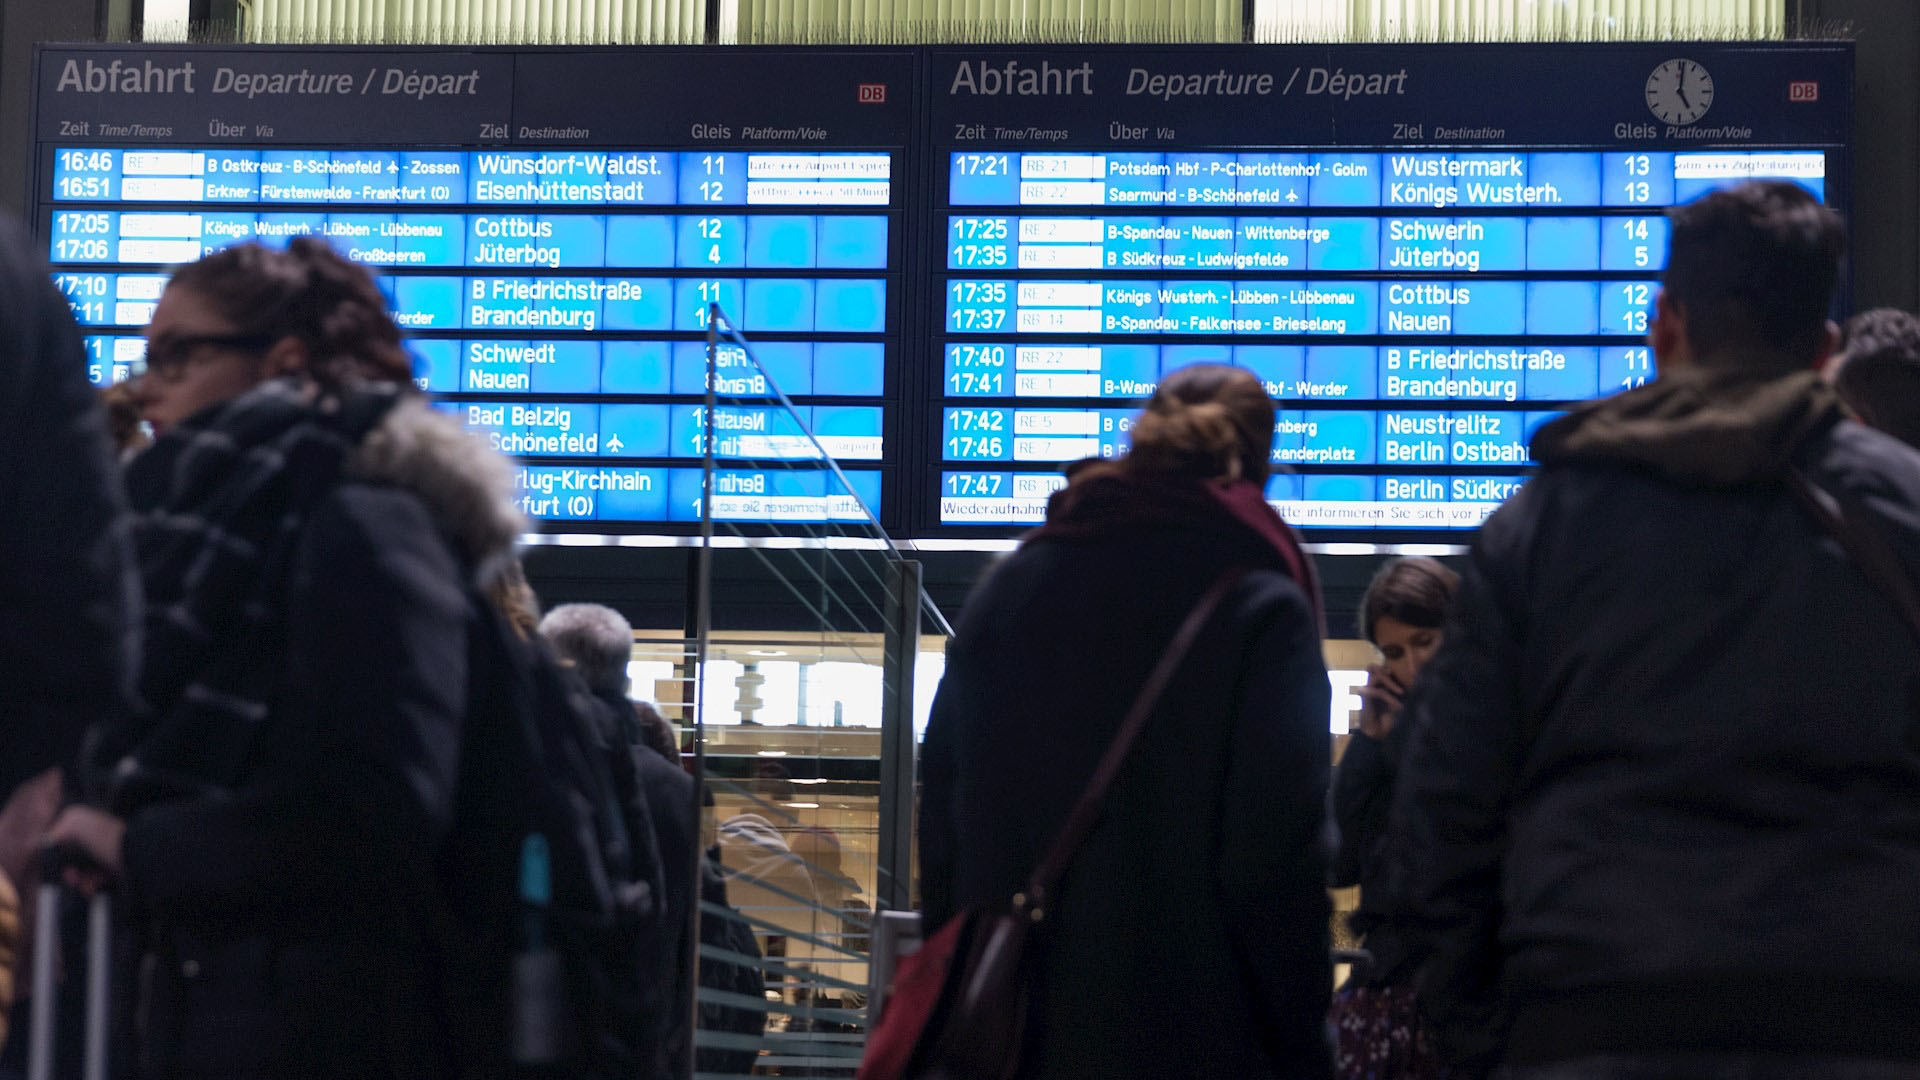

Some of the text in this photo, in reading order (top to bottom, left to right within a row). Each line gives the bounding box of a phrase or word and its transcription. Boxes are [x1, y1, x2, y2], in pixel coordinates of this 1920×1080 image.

[57, 60, 195, 93] Abfahrt
[213, 68, 353, 98] Departure
[382, 69, 479, 99] Départ
[950, 61, 1093, 95] Abfahrt
[1126, 69, 1273, 101] Departure
[1306, 69, 1407, 100] Départ
[861, 87, 883, 101] DB
[1792, 84, 1815, 99] DB
[60, 121, 172, 138] Zeit Time/Temps
[209, 120, 273, 136] Über Via
[480, 124, 589, 138] Ziel Destination
[692, 124, 827, 139] Gleis Platform/Voie
[955, 125, 1068, 141] Zeit Time/Temps
[1110, 122, 1174, 139] Über Via
[1393, 124, 1504, 138] Ziel Destination
[1615, 123, 1751, 138] Gleis Platform/Voie
[61, 151, 113, 172] 16:46
[207, 158, 460, 174] B Ostkreuz B-Schönefeld Zossen
[478, 155, 661, 175] Wünsdorf-Waldst.
[703, 156, 724, 175] 11
[956, 155, 1008, 175] 17:21
[1027, 159, 1068, 171] RB 21
[1110, 161, 1368, 177] Potsdam Hbf P-Charlottenhof Golm
[1391, 156, 1523, 177] Wustermark
[1625, 155, 1650, 176] 13
[59, 177, 110, 197] 16:51
[206, 183, 251, 198] Erkner
[261, 184, 353, 200] Fürstenwalde
[362, 185, 426, 200] Frankfurt
[476, 180, 644, 201] Eisenhüttenstadt
[699, 181, 723, 201] 12
[1026, 186, 1044, 198] RB
[1109, 187, 1280, 203] Saarmund B-Schönefeld
[1391, 182, 1562, 208] Königs Wusterh.
[1624, 181, 1649, 203] 13
[58, 213, 110, 234] 17:05
[205, 220, 443, 239] Königs Wusterh. Lübben Lübbenau
[475, 217, 553, 237] Cottbus
[698, 218, 722, 238] 12
[954, 219, 1008, 239] 17:25
[1025, 224, 1056, 235] RE 2
[1390, 220, 1484, 241] Schwerin
[1623, 219, 1649, 240] 14
[1108, 225, 1330, 243] B-Spandau Nauen Wittenberge
[56, 239, 109, 259] 17:06
[349, 248, 426, 262] Großbeeren
[474, 243, 561, 268] Jüterbog
[708, 244, 721, 263] 4
[953, 245, 1007, 265] 17:35
[1024, 250, 1056, 262] RE 3
[1635, 246, 1649, 267] 5
[1107, 251, 1289, 270] B Südkreuz Ludwigsfelde
[1389, 247, 1480, 272] Jüterbog
[472, 279, 642, 300] B Friedrichstraße
[698, 281, 720, 300] 11
[953, 282, 1006, 303] 17:35
[1023, 288, 1055, 300] RE 2
[1106, 289, 1355, 307] Königs Wusterh. Lübben Lübbenau
[1389, 284, 1470, 305] Cottbus
[1623, 284, 1649, 305] 12
[471, 305, 595, 331] Brandenburg
[952, 309, 1006, 329] 17:37
[1023, 314, 1064, 325] RB 14
[1106, 315, 1346, 334] B-Spandau Falkensee Brieselang
[1388, 311, 1451, 331] Nauen
[1623, 311, 1647, 332] 13
[470, 343, 556, 363] Schwedt
[951, 346, 1004, 367] 17:40
[1022, 352, 1063, 364] RB 22
[1387, 349, 1566, 370] B Friedrichstraße
[1624, 349, 1648, 370] 11
[469, 369, 529, 389] Nauen
[950, 373, 1002, 393] 17:41
[1021, 378, 1054, 390] RE 1
[1295, 381, 1348, 396] Werder
[1387, 375, 1517, 402] Brandenburg
[468, 405, 571, 431] Bad Belzig
[949, 410, 1003, 431] 17:42
[1020, 416, 1052, 427] RE 5
[1103, 417, 1113, 432] B
[1386, 414, 1501, 435] Neustrelitz
[949, 437, 1002, 457] 17:46
[1019, 442, 1051, 454] RE 7
[1103, 444, 1113, 457] B
[1272, 447, 1355, 463] xanderplatz
[1387, 441, 1444, 461] Berlin
[515, 471, 651, 494] rlug-Kirchhain
[948, 475, 1002, 494] 17:47
[1019, 480, 1060, 491] RB 10
[1386, 479, 1443, 499] Berlin
[944, 502, 1047, 516] Wiederaufnahm
[1307, 504, 1384, 519] informieren
[1392, 508, 1410, 518] Sie
[1419, 508, 1443, 518] sich
